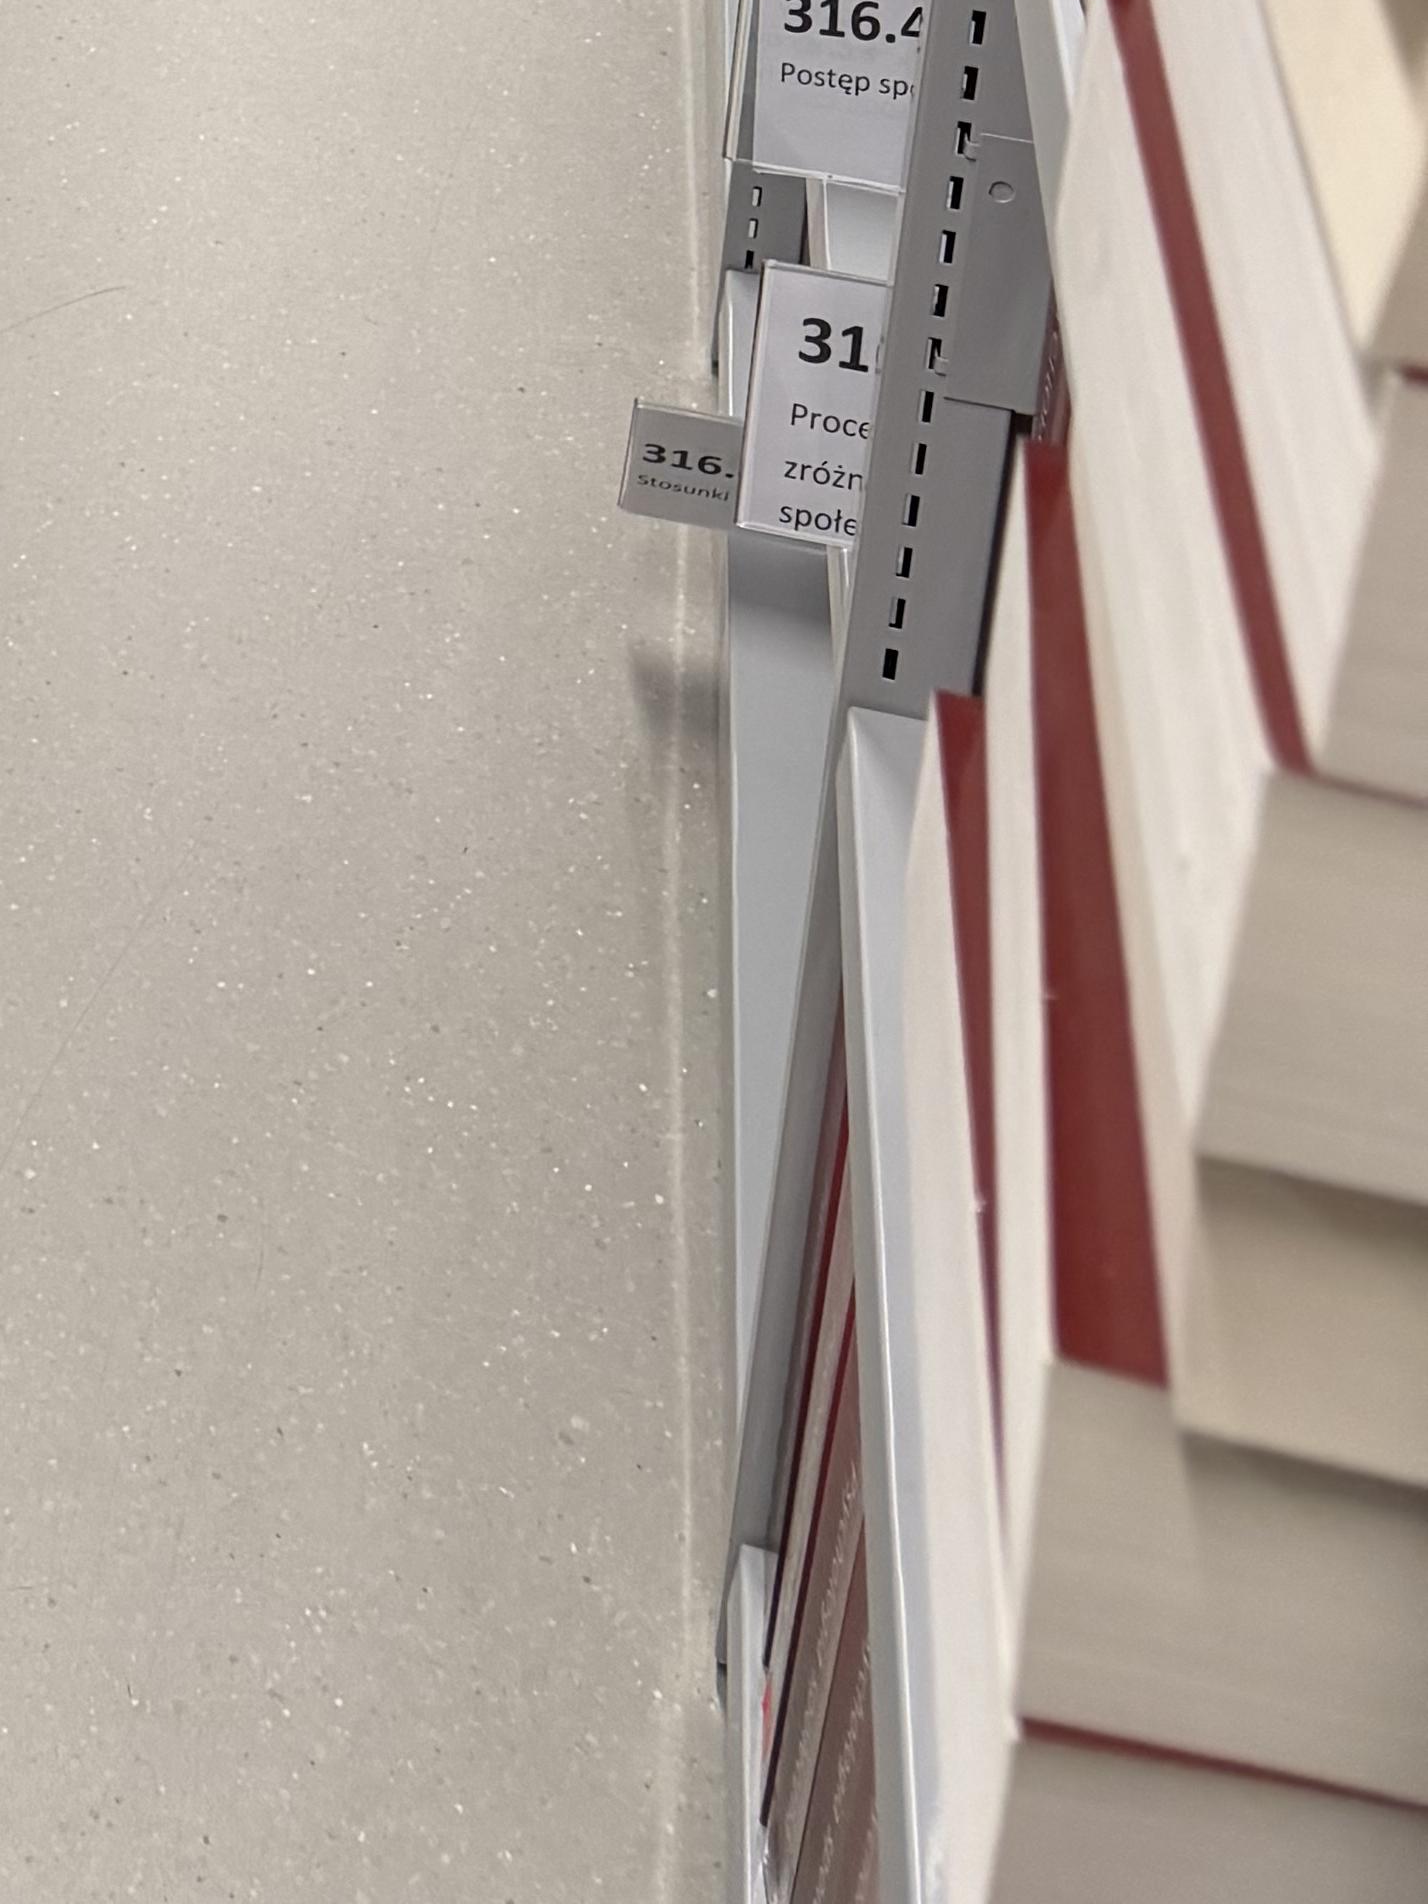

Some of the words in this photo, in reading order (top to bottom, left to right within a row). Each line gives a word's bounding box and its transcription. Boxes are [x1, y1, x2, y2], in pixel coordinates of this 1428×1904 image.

[779, 62, 871, 96] Postęp
[877, 76, 914, 101] spo
[797, 317, 869, 374] 31
[790, 402, 873, 441] Proce
[642, 441, 736, 479] 316.
[783, 454, 863, 491] zróżn
[636, 473, 731, 503] Stosunki
[777, 501, 858, 540] społe
